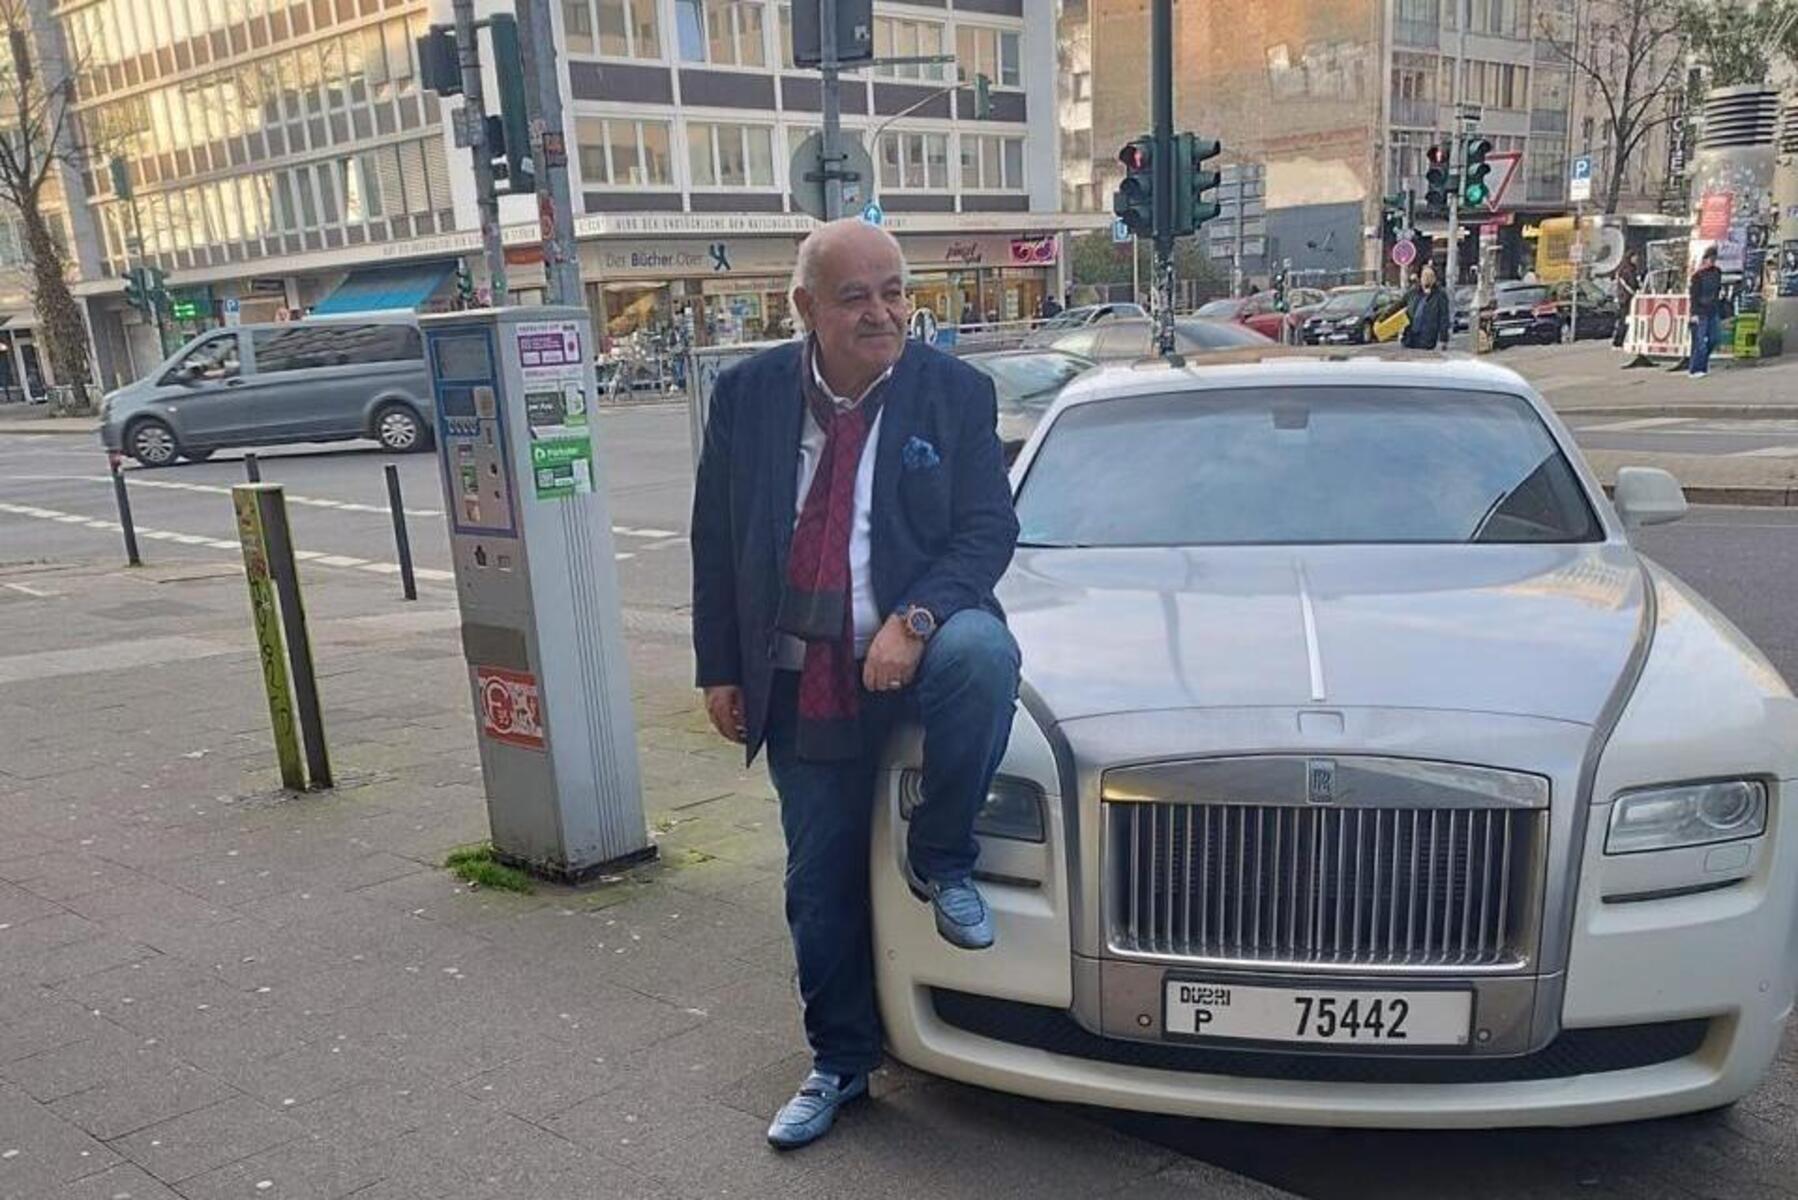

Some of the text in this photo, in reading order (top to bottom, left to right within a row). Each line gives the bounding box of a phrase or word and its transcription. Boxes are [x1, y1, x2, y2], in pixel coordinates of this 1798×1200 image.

[632, 251, 673, 267] Bücher
[1194, 1008, 1213, 1033] P
[1294, 996, 1410, 1039] 75442
